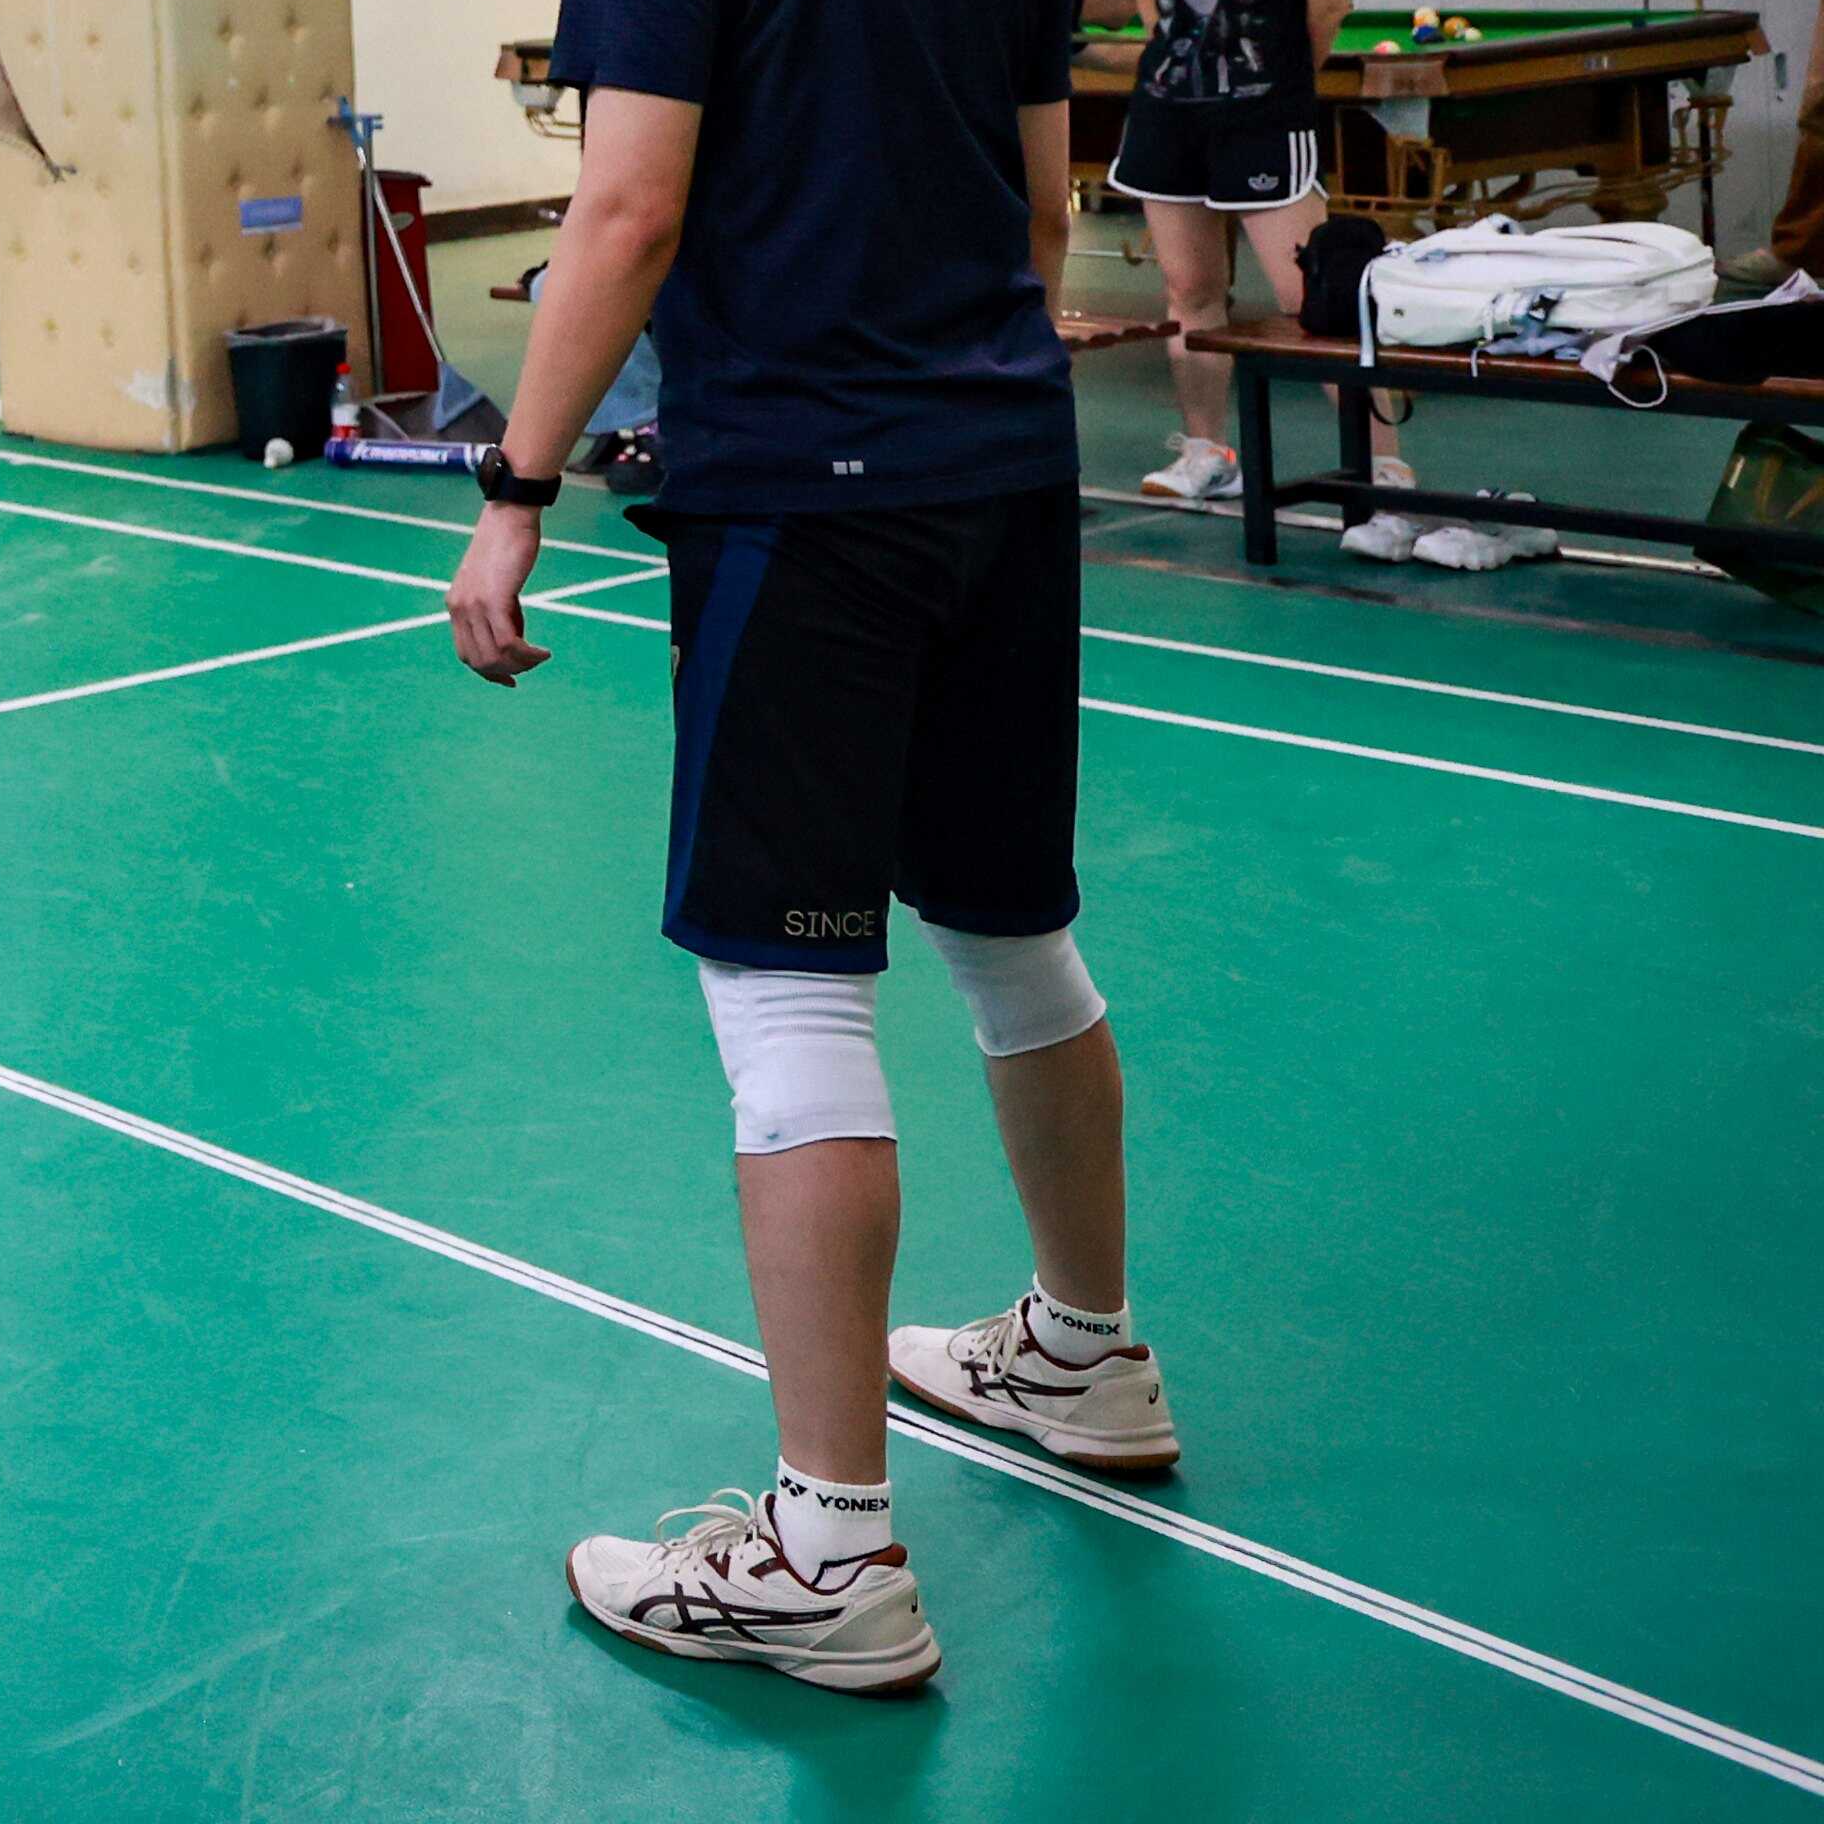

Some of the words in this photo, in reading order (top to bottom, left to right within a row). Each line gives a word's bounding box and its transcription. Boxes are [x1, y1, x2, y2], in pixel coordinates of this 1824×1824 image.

[784, 910, 875, 938] SINCE
[1047, 1306, 1120, 1335] YONEX
[815, 1492, 890, 1512] YONEX
